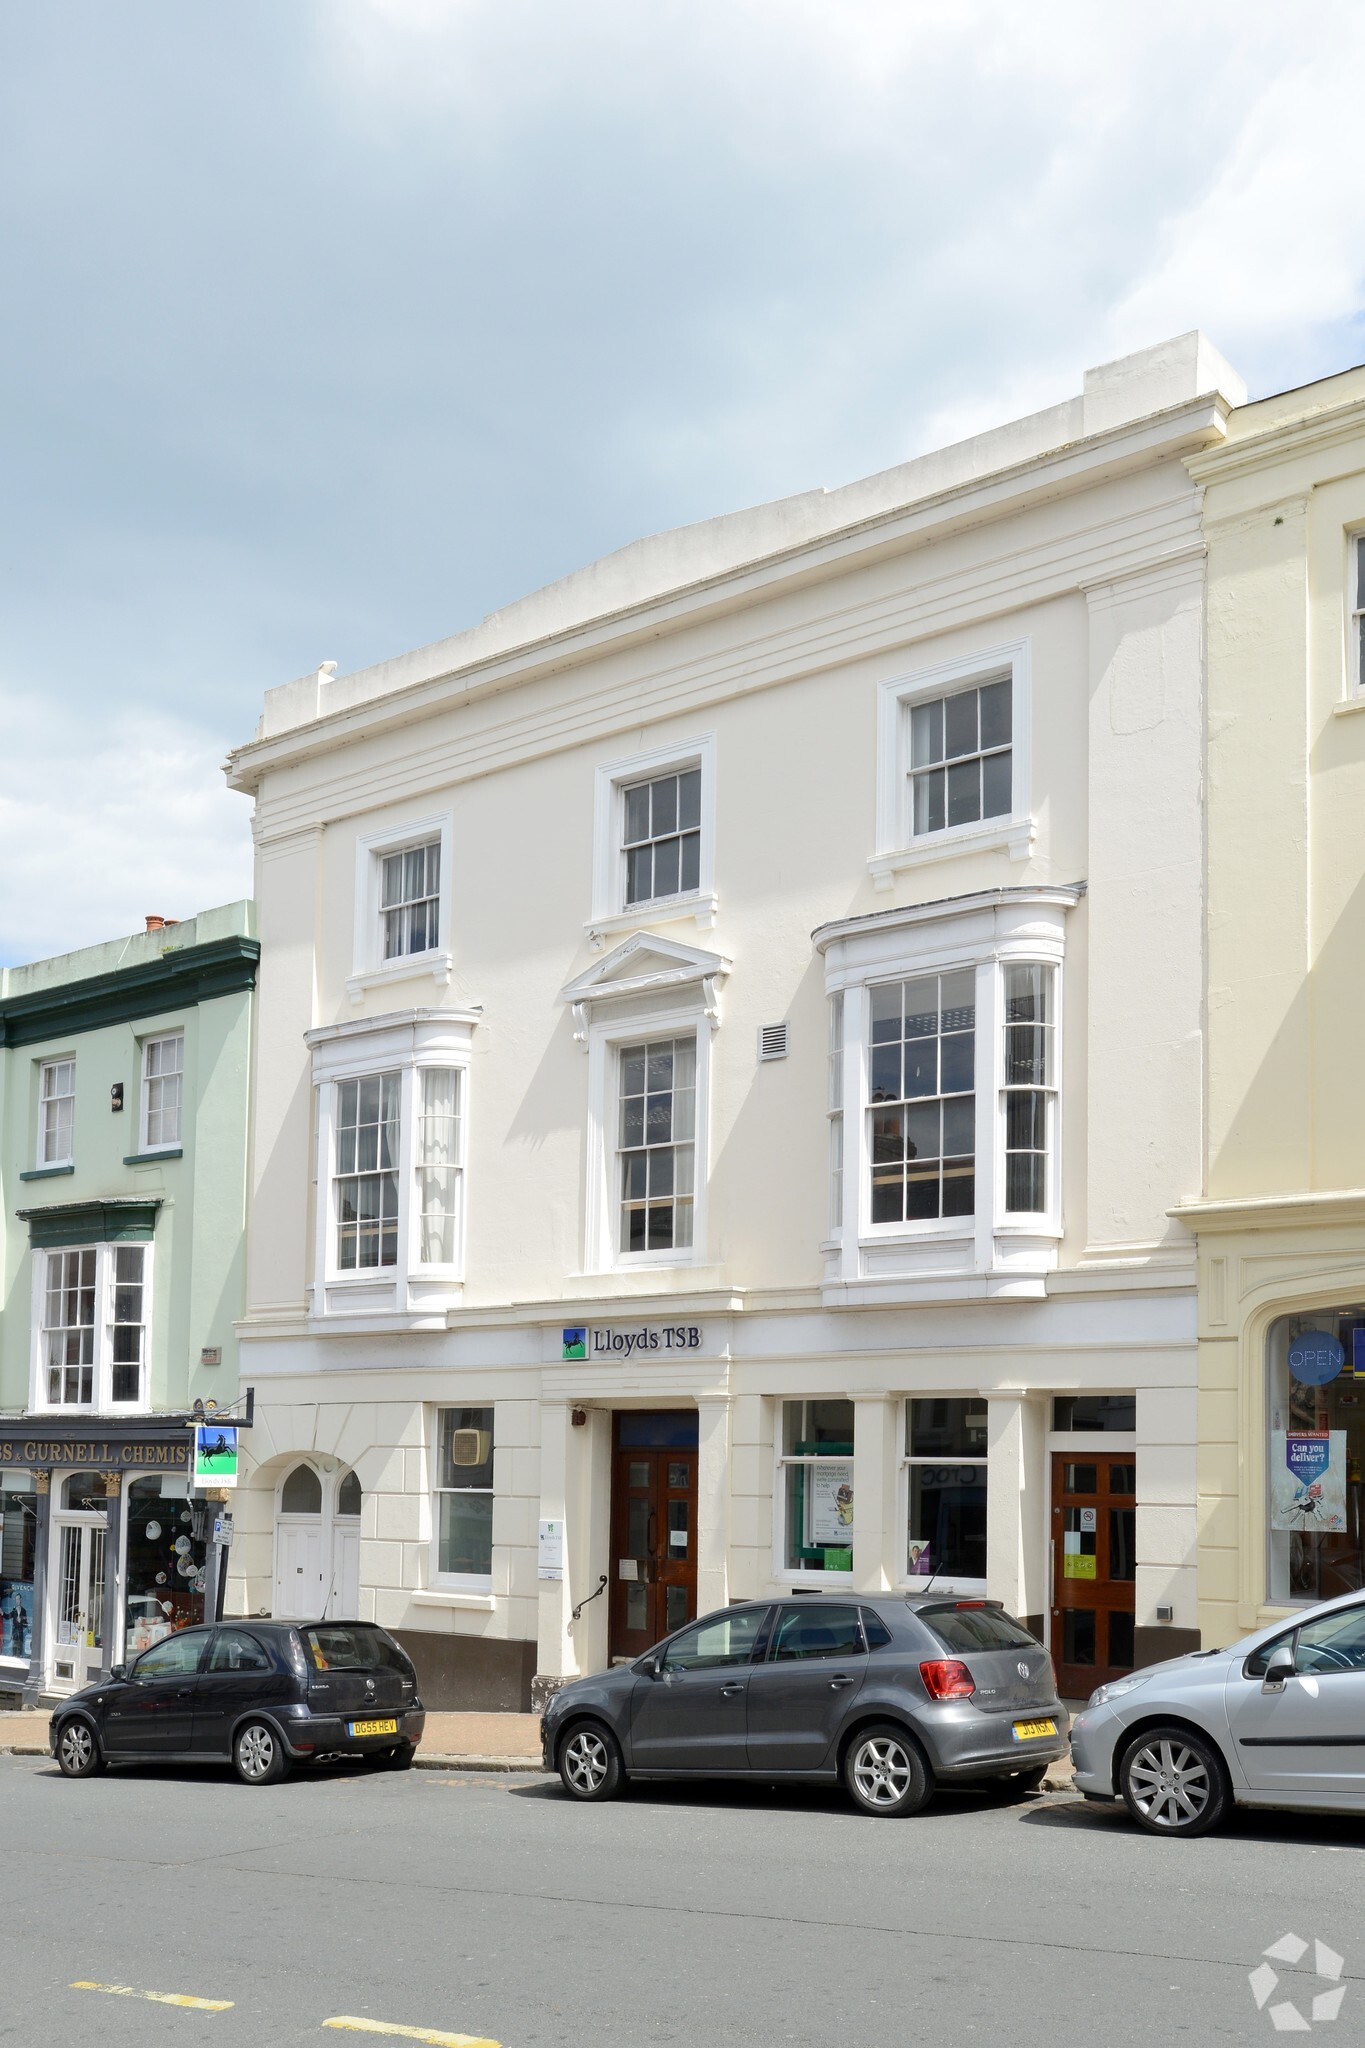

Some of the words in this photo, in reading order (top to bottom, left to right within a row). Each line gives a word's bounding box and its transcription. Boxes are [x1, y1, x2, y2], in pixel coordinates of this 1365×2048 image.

[594, 1328, 659, 1357] Lloyds
[663, 1327, 701, 1349] TSB
[1289, 1350, 1341, 1366] OPEN
[0, 1443, 13, 1461] S
[16, 1453, 22, 1461] &
[24, 1442, 119, 1464] GURNELL,
[1292, 1443, 1307, 1452] Can
[1309, 1445, 1324, 1453] you
[1291, 1453, 1325, 1462] deliver?
[355, 1722, 378, 1734] DG55
[379, 1721, 395, 1732] HEV
